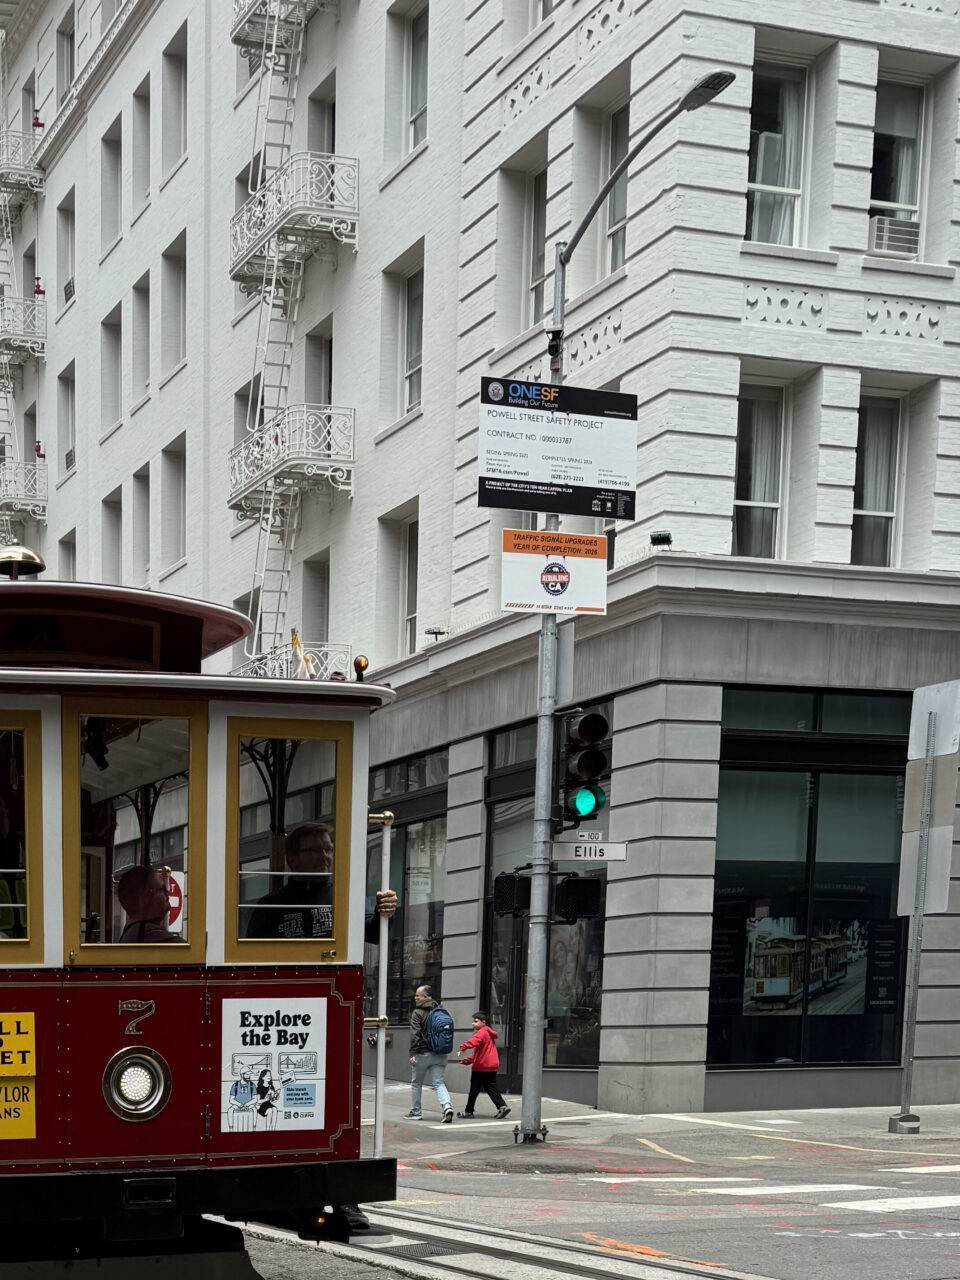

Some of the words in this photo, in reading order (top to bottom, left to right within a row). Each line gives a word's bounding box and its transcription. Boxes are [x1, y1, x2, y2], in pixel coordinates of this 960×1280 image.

[508, 383, 559, 401] ONESF
[508, 396, 528, 406] Building
[542, 400, 559, 408] Future
[487, 409, 517, 421] POWELL
[519, 413, 544, 423] STREET
[546, 416, 572, 427] SAFETY
[574, 418, 604, 430] PROJECT
[486, 430, 524, 440] CONTRACT
[513, 534, 540, 542] TRAFFIC
[541, 536, 563, 544] SIGNAL
[564, 538, 598, 546] UPGRADES
[548, 582, 562, 591] CA
[588, 832, 600, 840] 100
[574, 846, 605, 858] Ellis
[119, 1000, 156, 1034] 7
[240, 1010, 311, 1032] Explore
[241, 1029, 272, 1046] the
[276, 1029, 310, 1050] Bay
